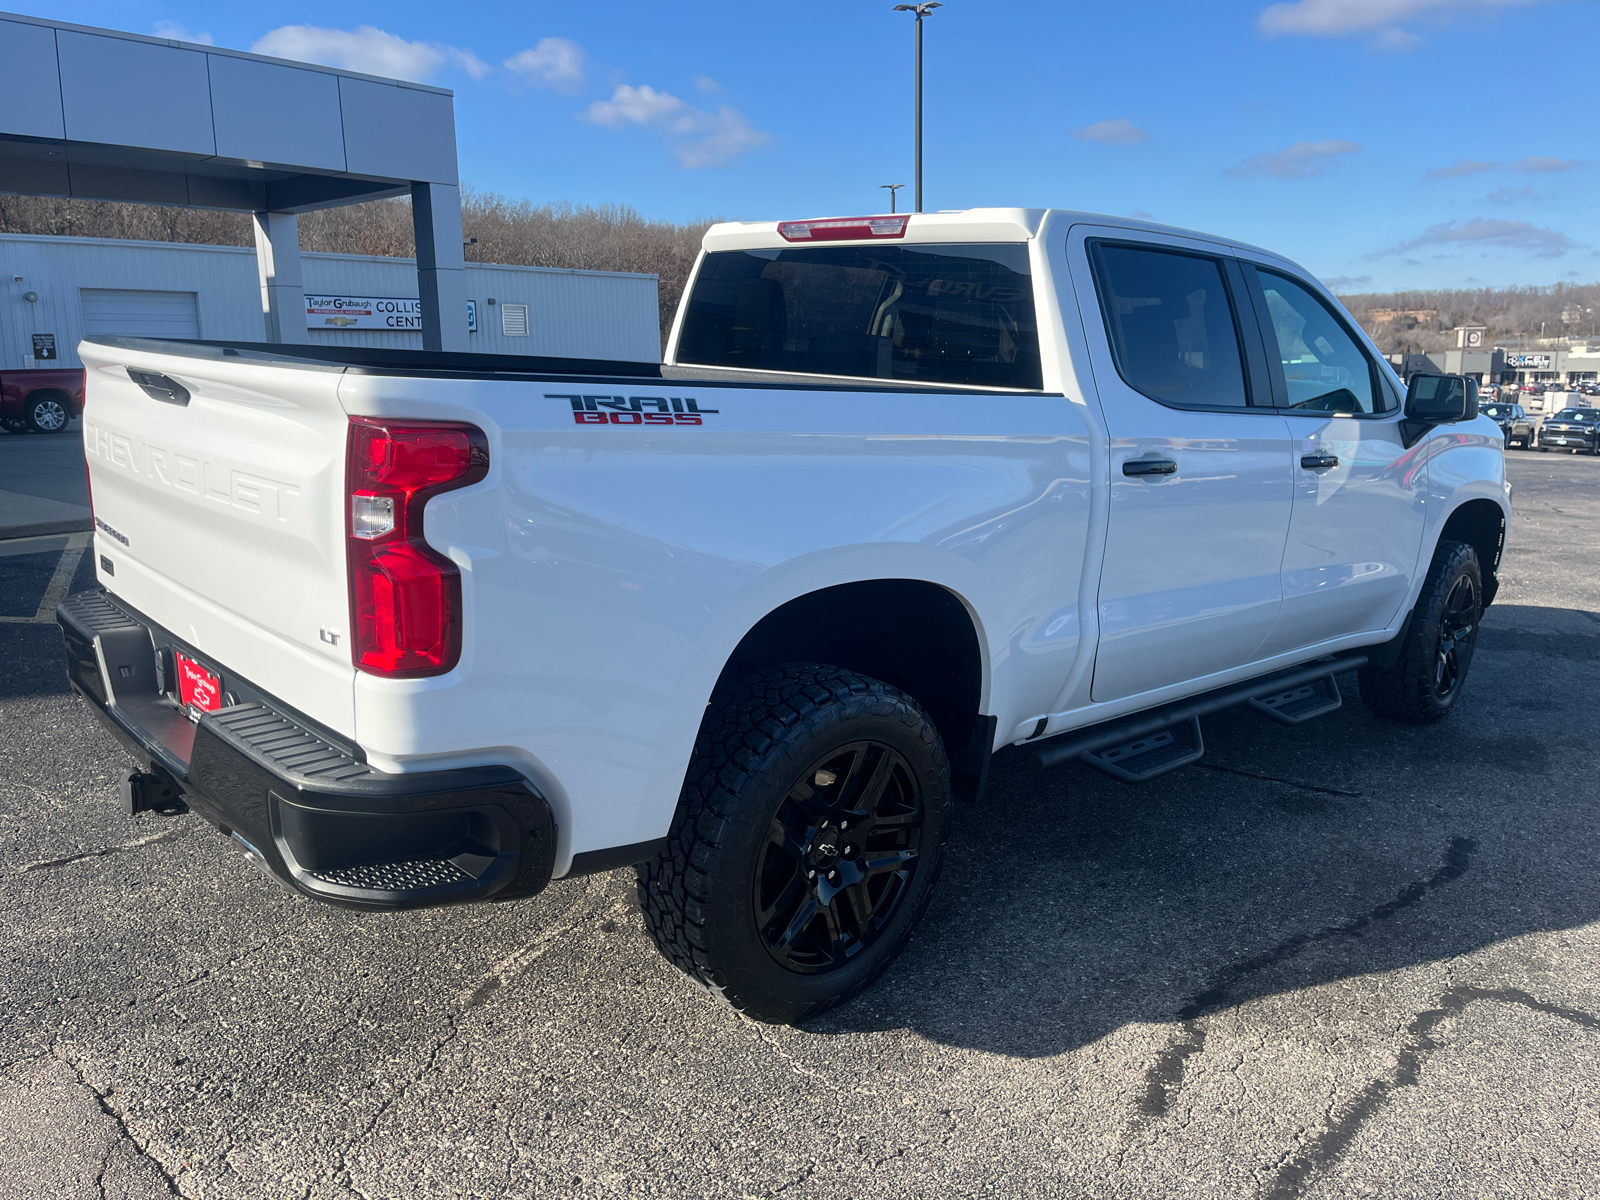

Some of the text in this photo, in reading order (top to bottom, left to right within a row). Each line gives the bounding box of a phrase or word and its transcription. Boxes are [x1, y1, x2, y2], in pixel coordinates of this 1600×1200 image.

[306, 297, 372, 309] Taylor Grubaugh
[543, 394, 720, 413] TRAIL
[573, 411, 703, 426] BOSS
[84, 420, 301, 523] CHEVROLET
[319, 627, 341, 647] LT
